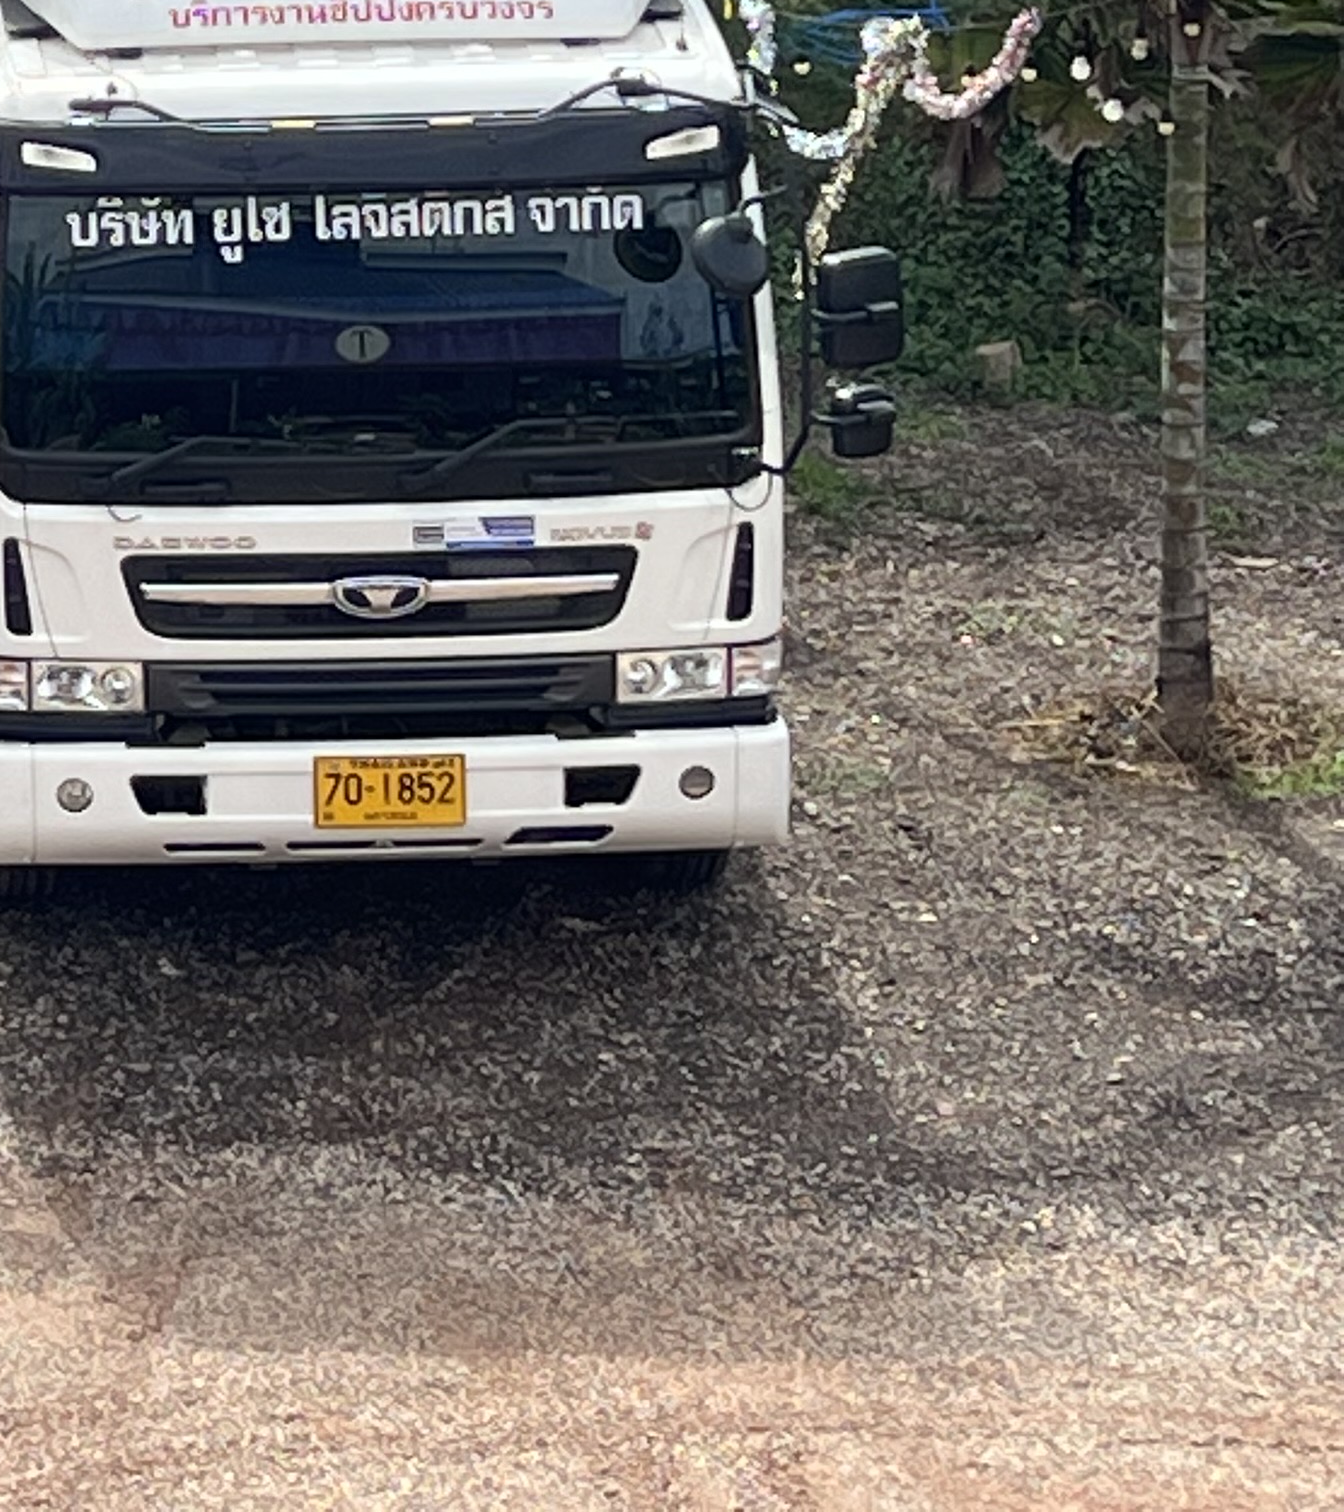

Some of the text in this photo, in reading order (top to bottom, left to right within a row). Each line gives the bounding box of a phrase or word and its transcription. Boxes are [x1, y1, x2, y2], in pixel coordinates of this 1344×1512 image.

[64, 195, 195, 247] บริษัท
[314, 190, 516, 240] โลจสตกส
[112, 536, 258, 550] DAEWOO
[323, 771, 456, 808] 70-1852
